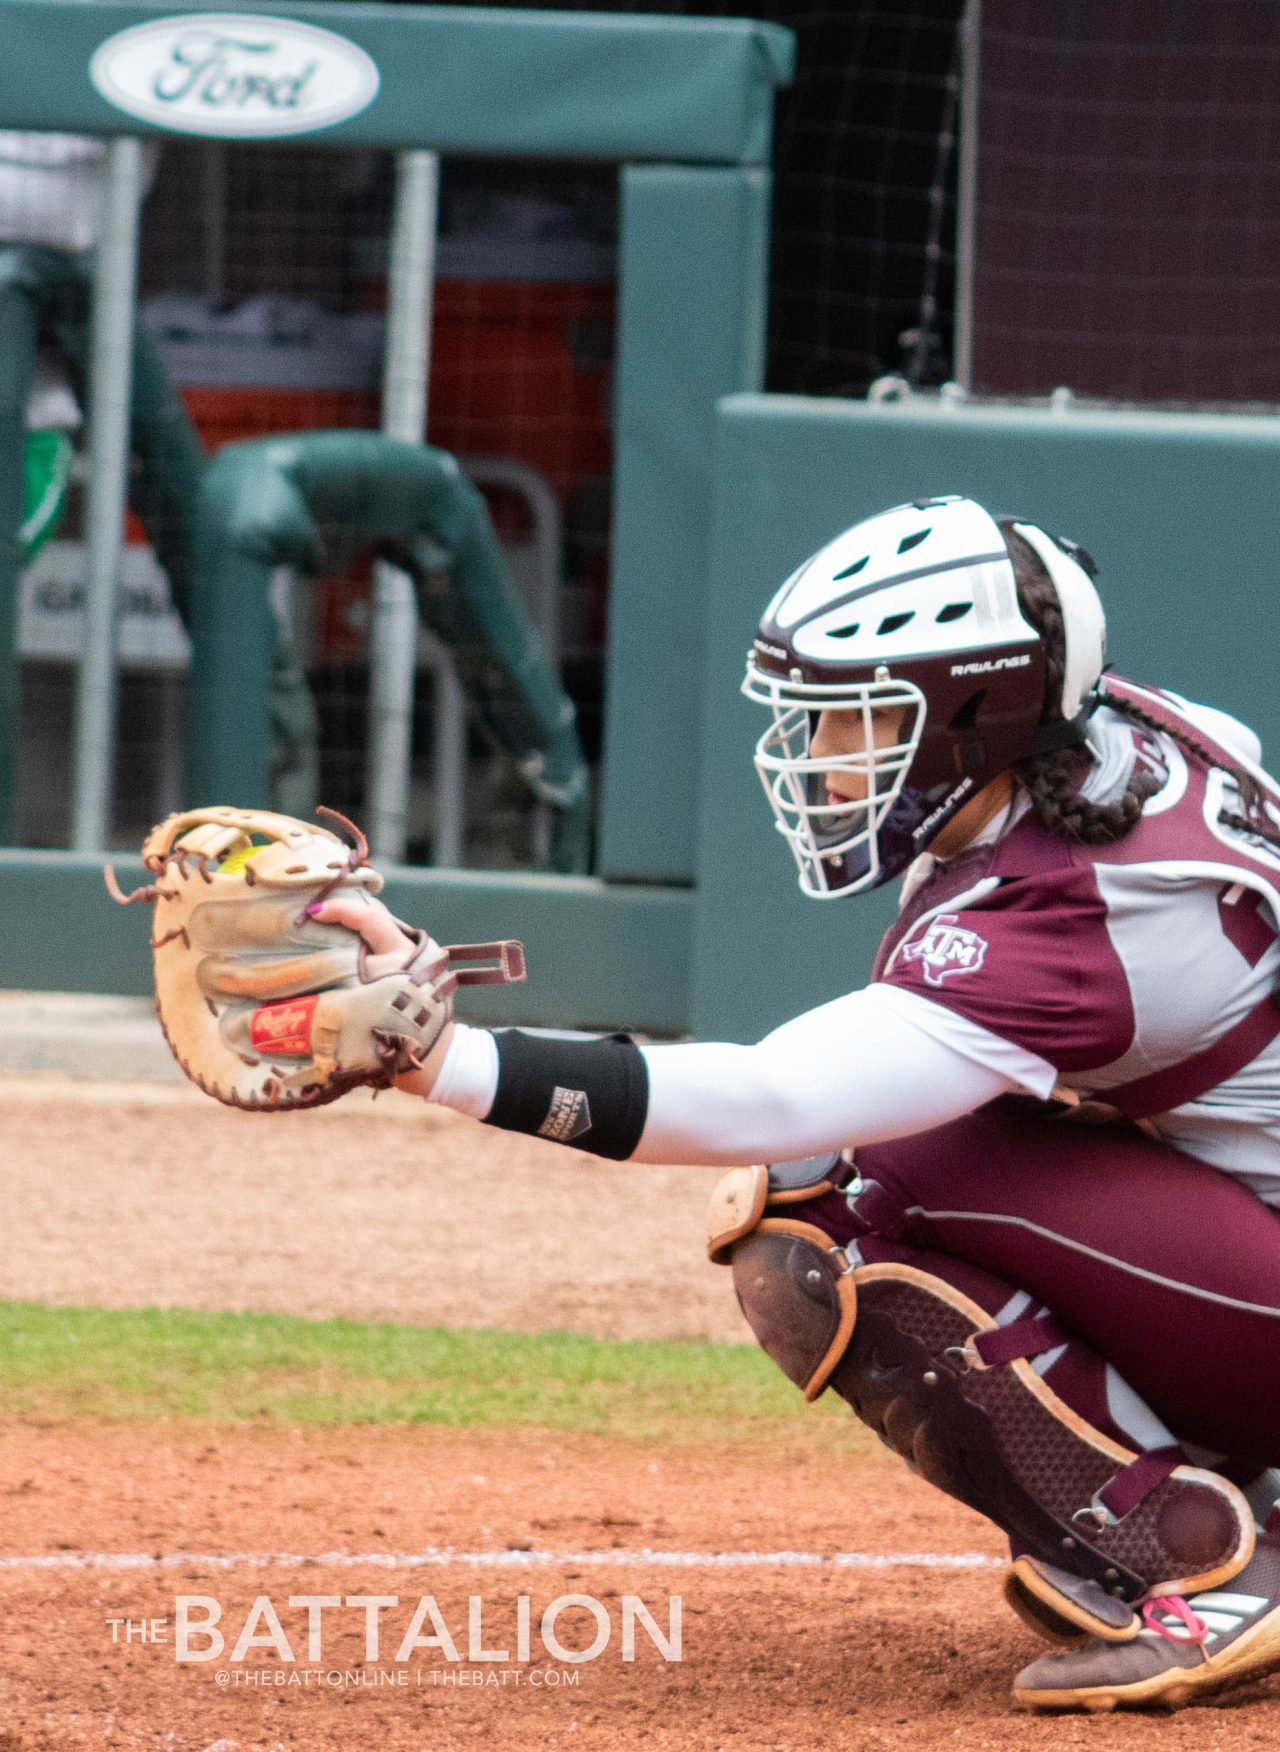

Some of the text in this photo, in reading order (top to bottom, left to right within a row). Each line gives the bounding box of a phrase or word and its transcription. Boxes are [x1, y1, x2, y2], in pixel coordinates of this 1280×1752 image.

[152, 30, 318, 108] Ford
[951, 654, 1031, 677] RAWLINGS
[911, 776, 974, 840] RAWLINGS
